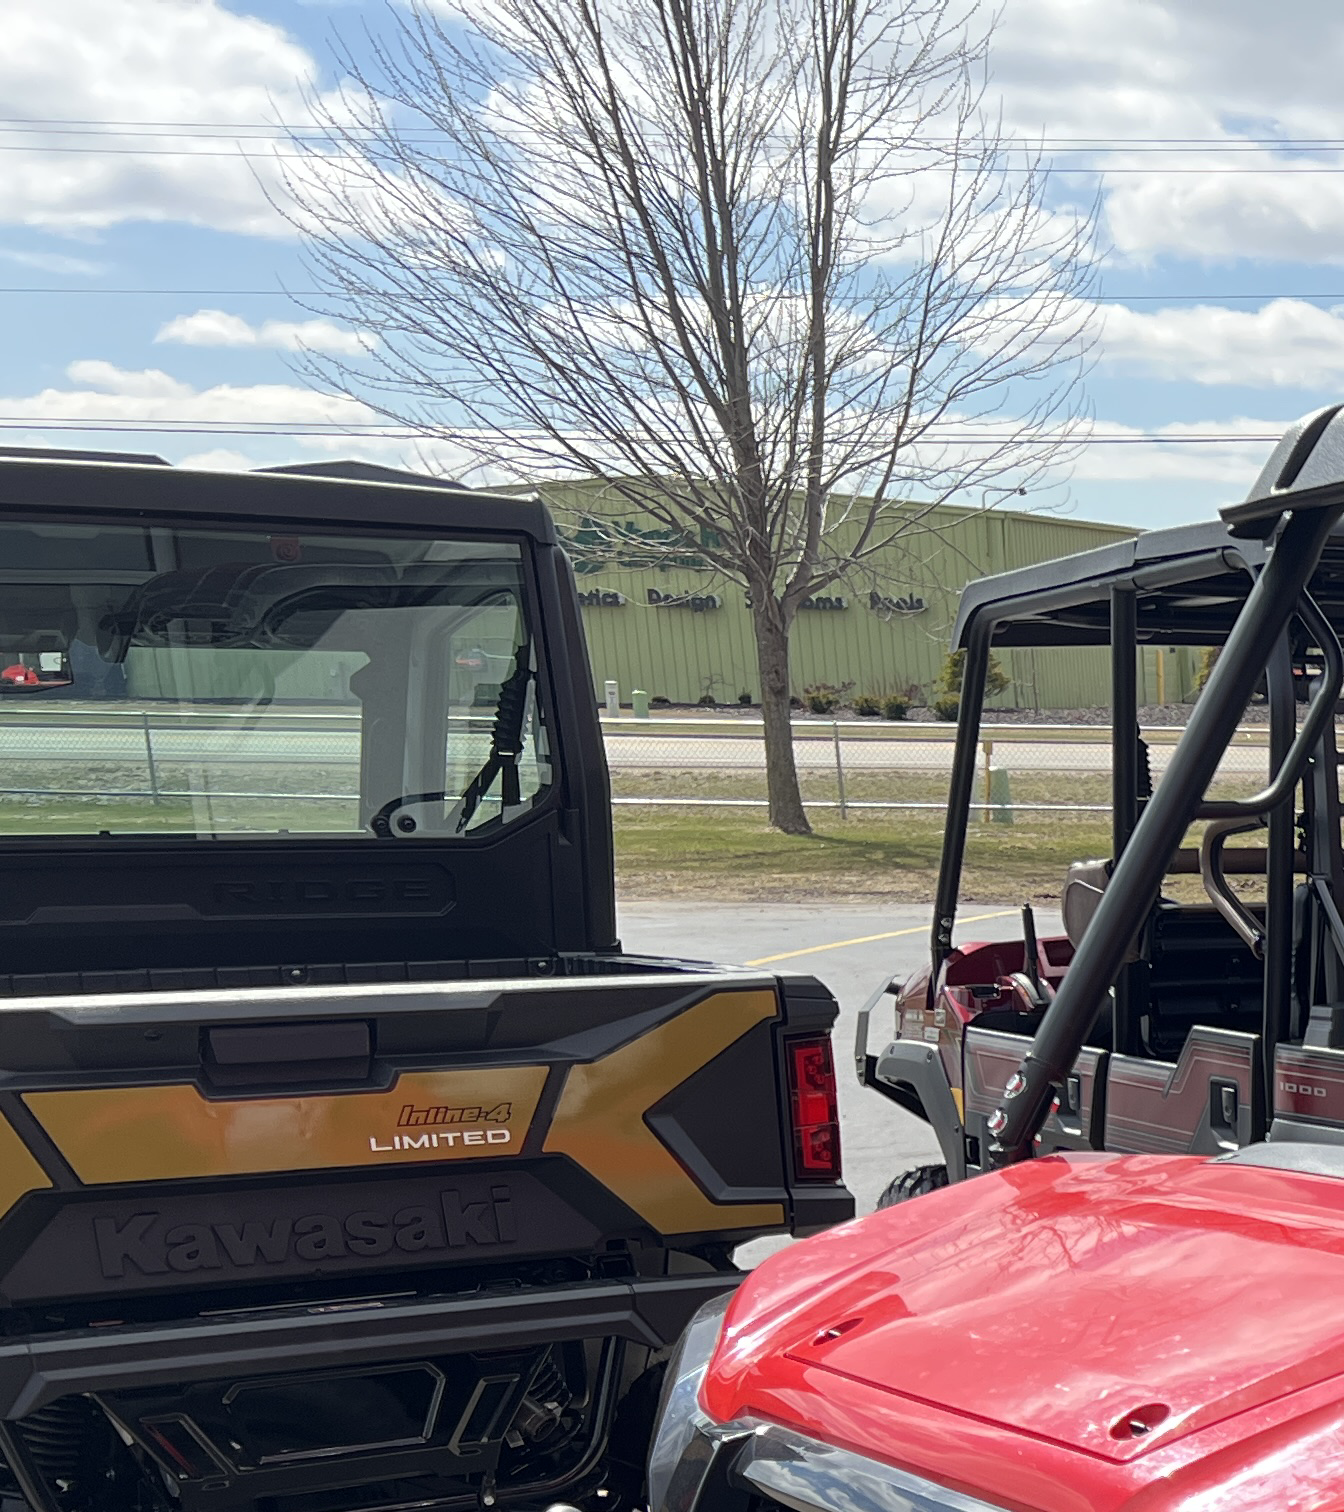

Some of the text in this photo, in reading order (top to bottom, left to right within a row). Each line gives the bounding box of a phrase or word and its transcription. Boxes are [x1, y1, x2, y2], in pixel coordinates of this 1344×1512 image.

[647, 588, 717, 612] Design
[213, 878, 433, 901] RIDGE
[1280, 1081, 1327, 1097] 1000
[397, 1102, 513, 1128] Inline-4
[370, 1129, 511, 1151] LIMITED
[93, 1185, 517, 1279] Kawasaki
